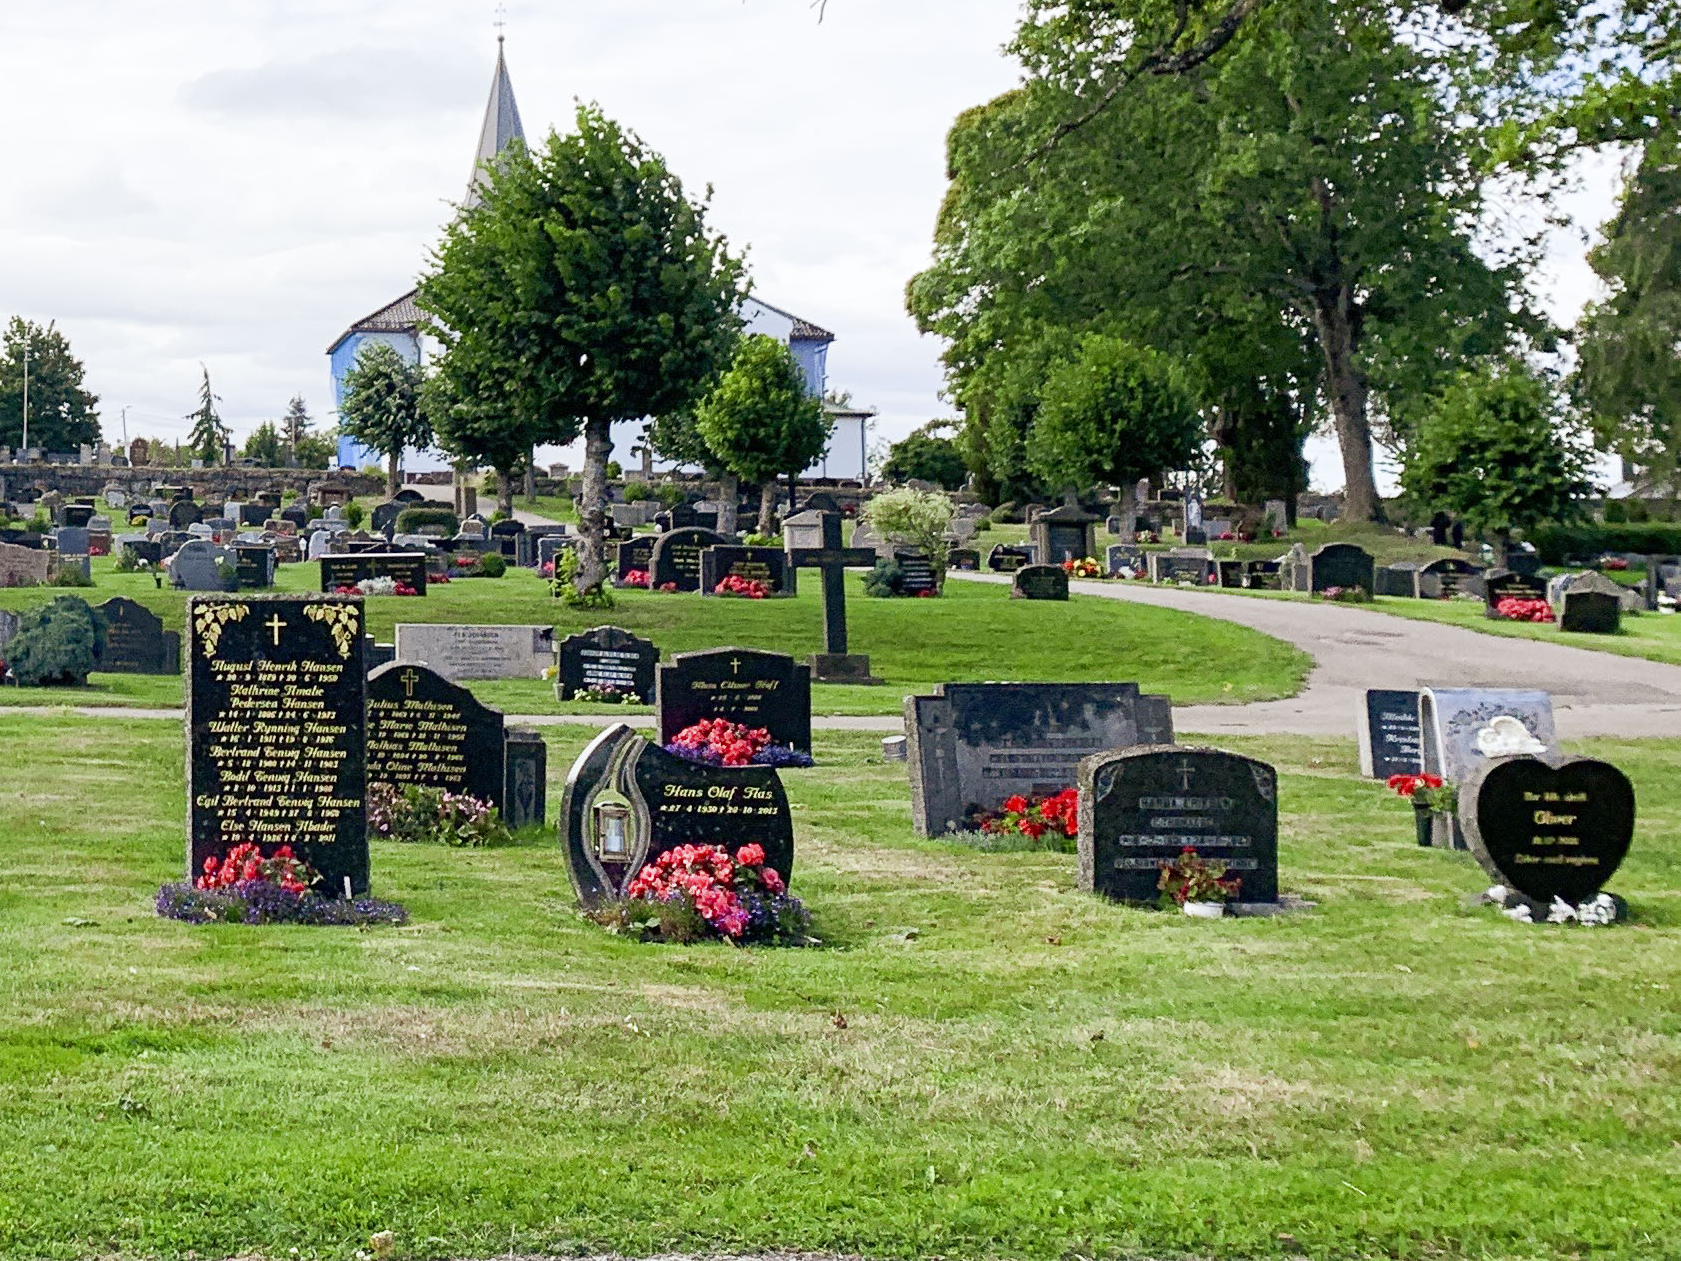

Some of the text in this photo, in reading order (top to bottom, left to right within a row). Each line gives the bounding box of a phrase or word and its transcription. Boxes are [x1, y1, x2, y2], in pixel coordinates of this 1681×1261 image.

[211, 660, 343, 673] August Henrik Hansen
[230, 684, 324, 696] Kathrine Amalie
[230, 697, 325, 709] Pedersen Hansen
[208, 721, 347, 735] Walter Rynning Hansen
[209, 746, 261, 758] Bertrand
[304, 747, 347, 758] Hansen
[220, 770, 251, 782] Bodil
[295, 771, 337, 782] Hansen
[664, 785, 703, 797] Hans
[708, 786, 738, 800] Olaf
[196, 794, 219, 808] Egil
[222, 795, 274, 806] Bertrand
[317, 796, 361, 807] Hansen
[221, 820, 244, 831] Else
[248, 820, 291, 832] Hansen
